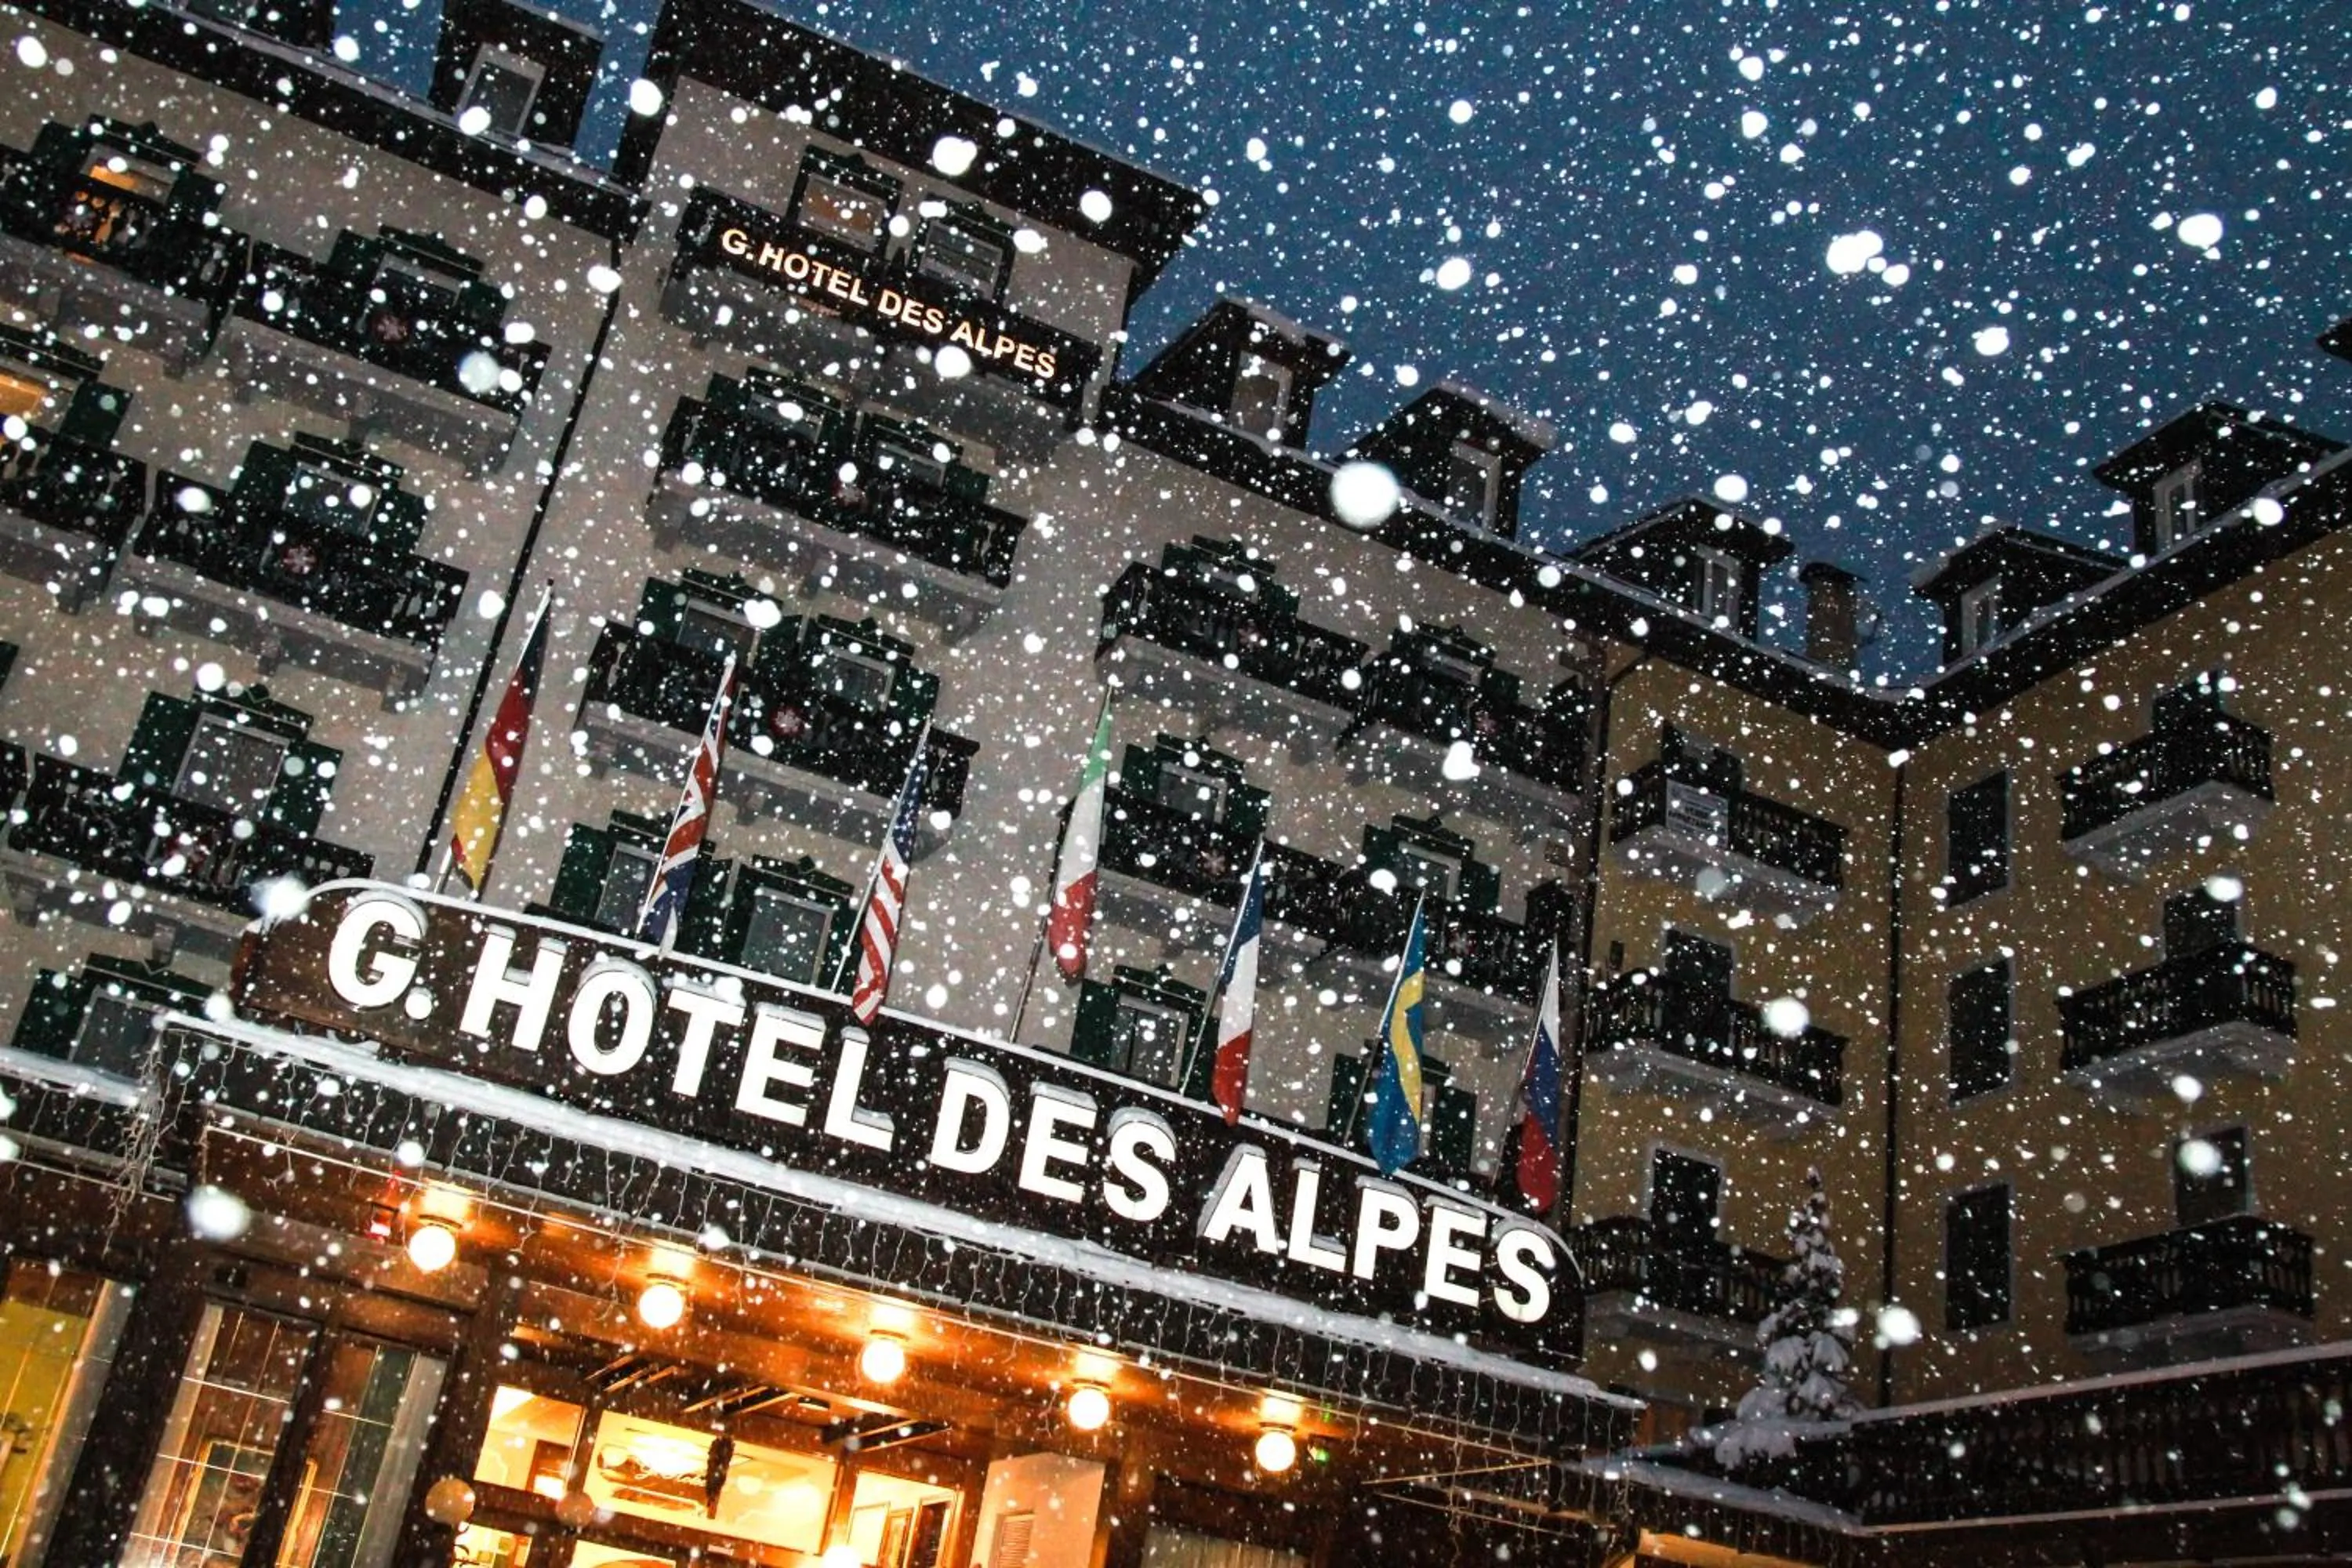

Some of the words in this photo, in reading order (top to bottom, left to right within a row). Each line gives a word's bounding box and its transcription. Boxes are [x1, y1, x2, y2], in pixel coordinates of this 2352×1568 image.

[877, 290, 942, 334] DES
[951, 322, 1055, 378] ALPES
[931, 1065, 1175, 1221] DES
[1203, 1147, 1555, 1323] ALPES
